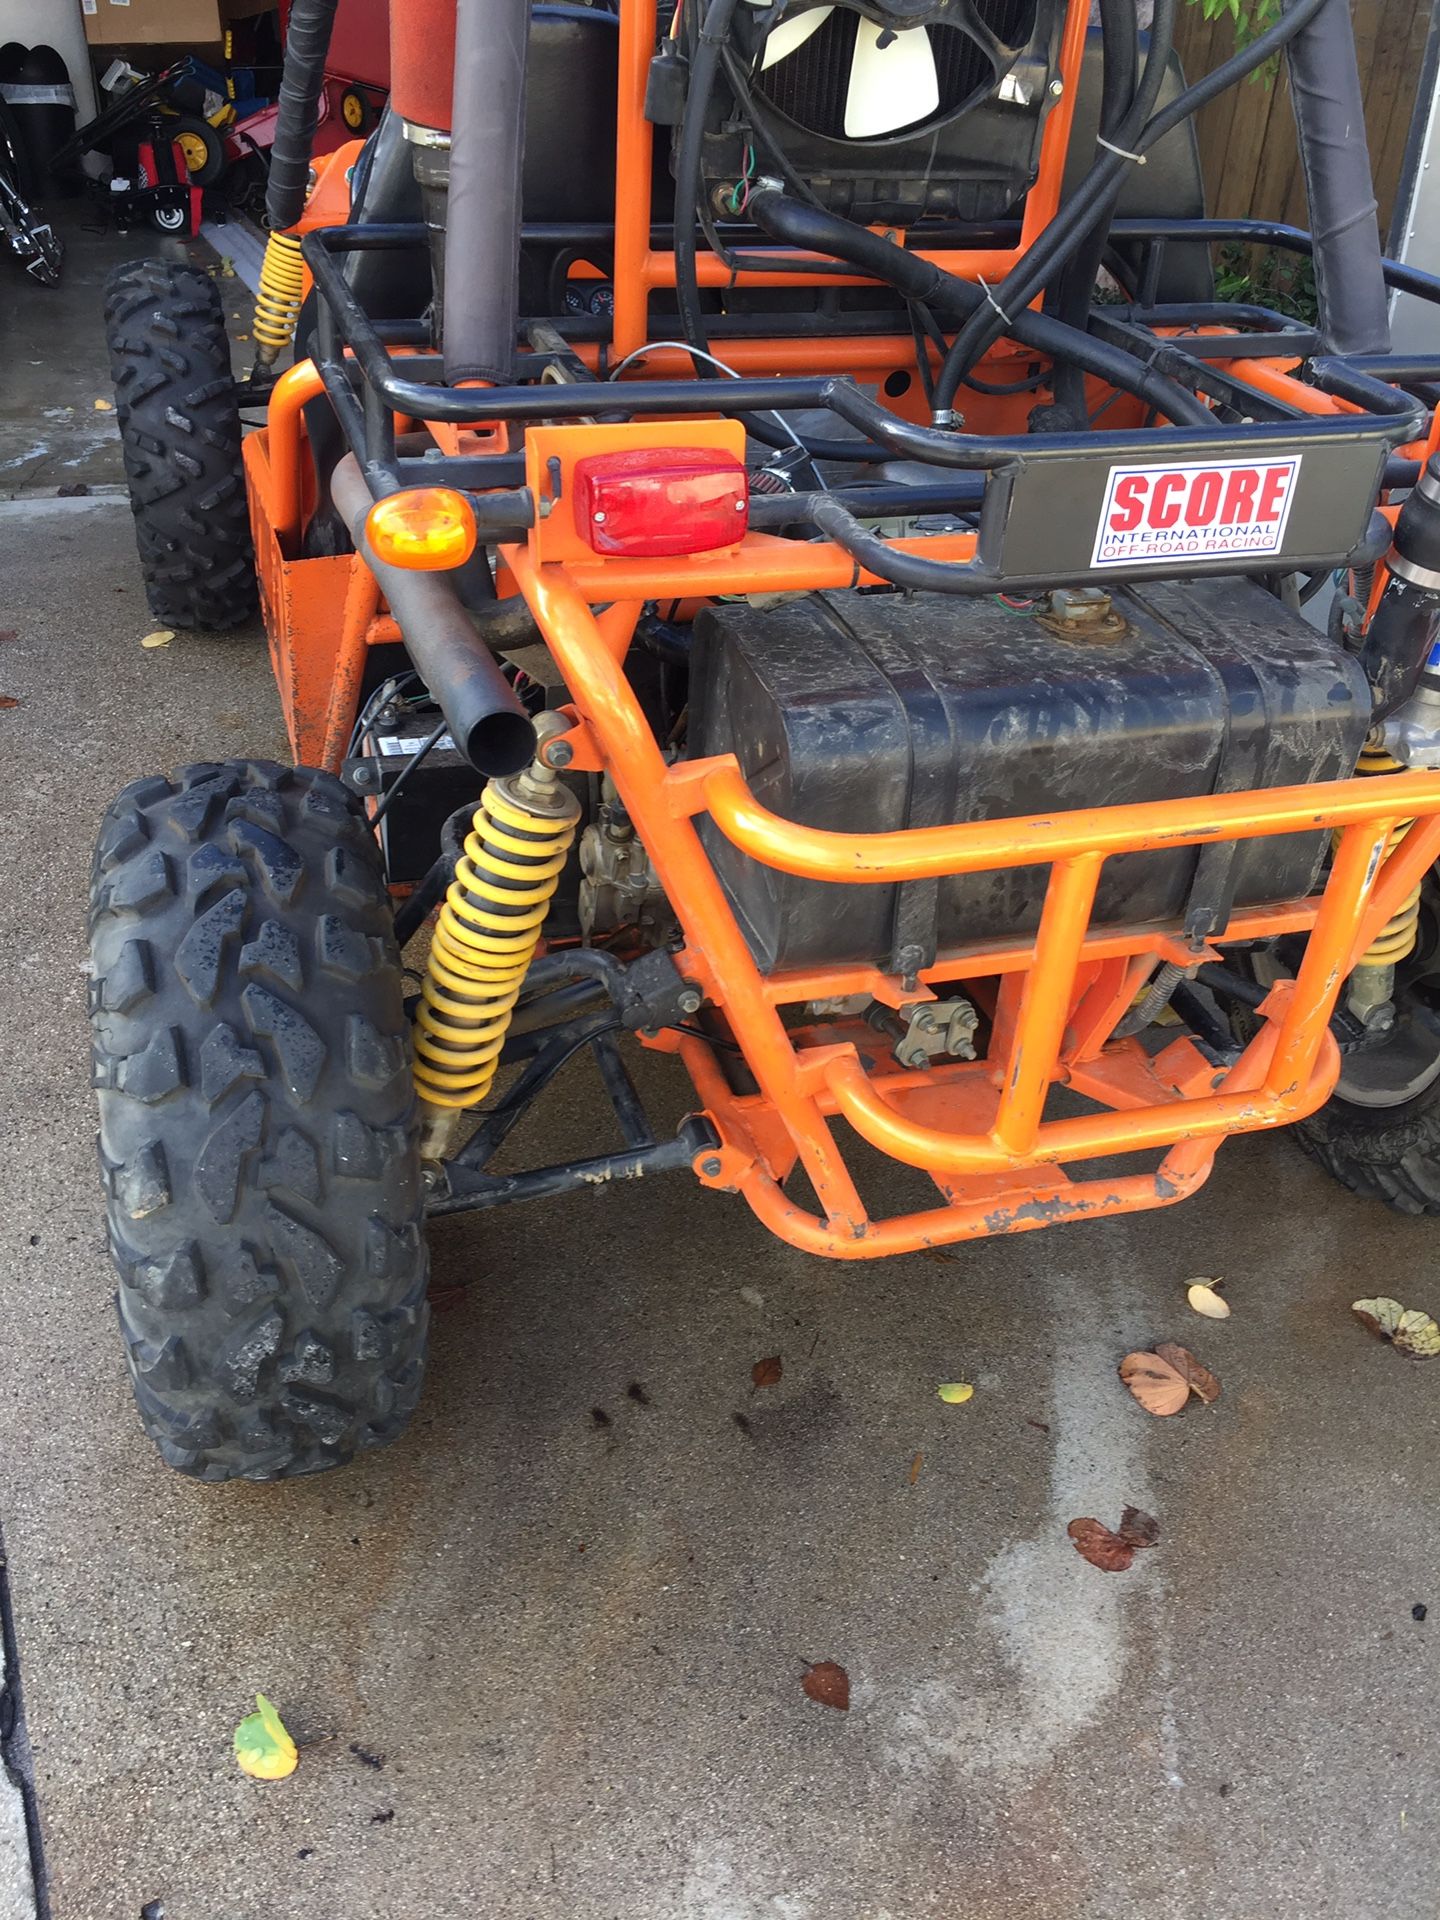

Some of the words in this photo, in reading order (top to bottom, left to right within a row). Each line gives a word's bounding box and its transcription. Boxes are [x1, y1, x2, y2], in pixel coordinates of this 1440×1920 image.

[1109, 466, 1290, 532] SCORE
[1103, 540, 1199, 558] OFF-ROAD
[1205, 535, 1275, 550] RACING
[1105, 525, 1276, 545] INTERNATIONAL
